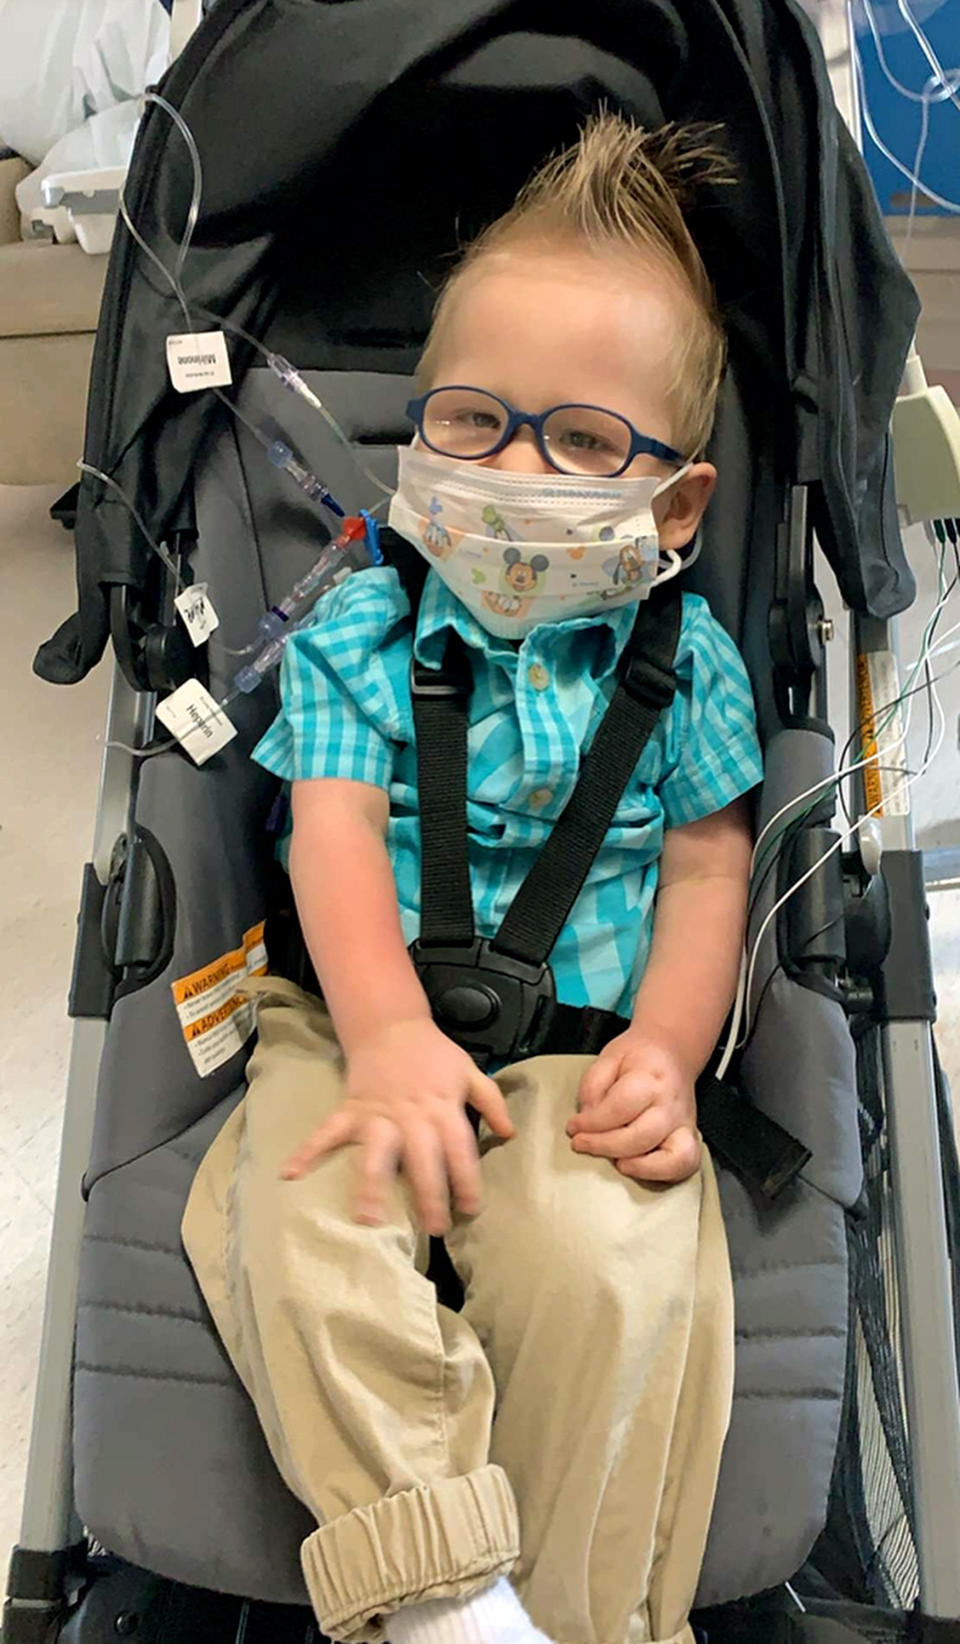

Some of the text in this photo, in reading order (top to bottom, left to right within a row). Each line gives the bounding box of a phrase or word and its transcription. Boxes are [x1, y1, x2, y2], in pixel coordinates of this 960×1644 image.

[177, 354, 216, 365] Milrinone
[186, 703, 214, 739] Heparin
[192, 963, 231, 995] WARNING
